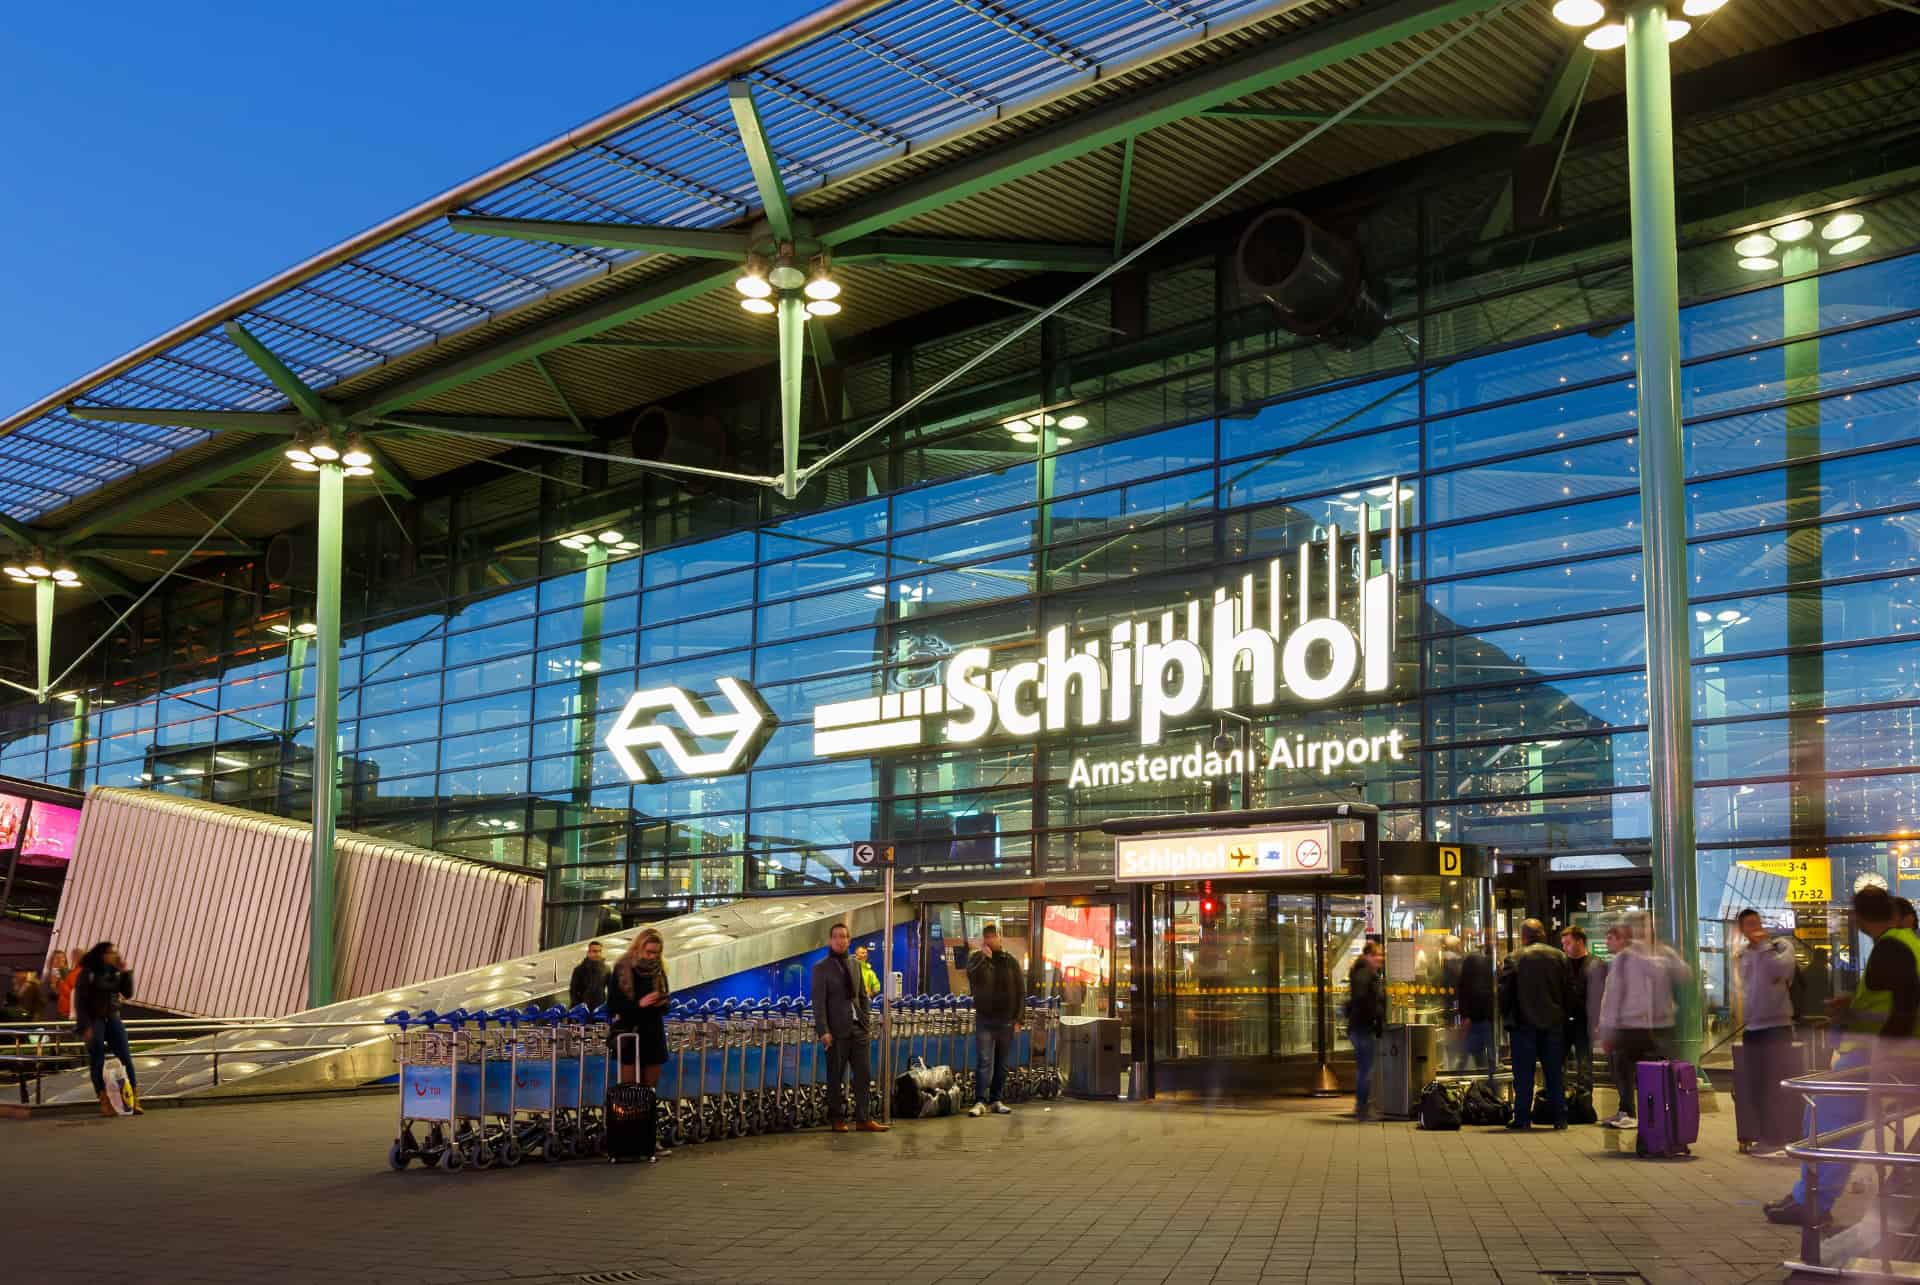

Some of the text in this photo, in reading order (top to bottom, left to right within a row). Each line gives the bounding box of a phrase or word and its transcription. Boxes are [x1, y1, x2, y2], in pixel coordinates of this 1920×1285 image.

[945, 571, 1392, 745] Schiphol
[1068, 729, 1404, 789] Amsterdam Airport
[1124, 843, 1225, 876] Schiphol
[1444, 851, 1457, 871] D
[1791, 890, 1824, 900] 17-32
